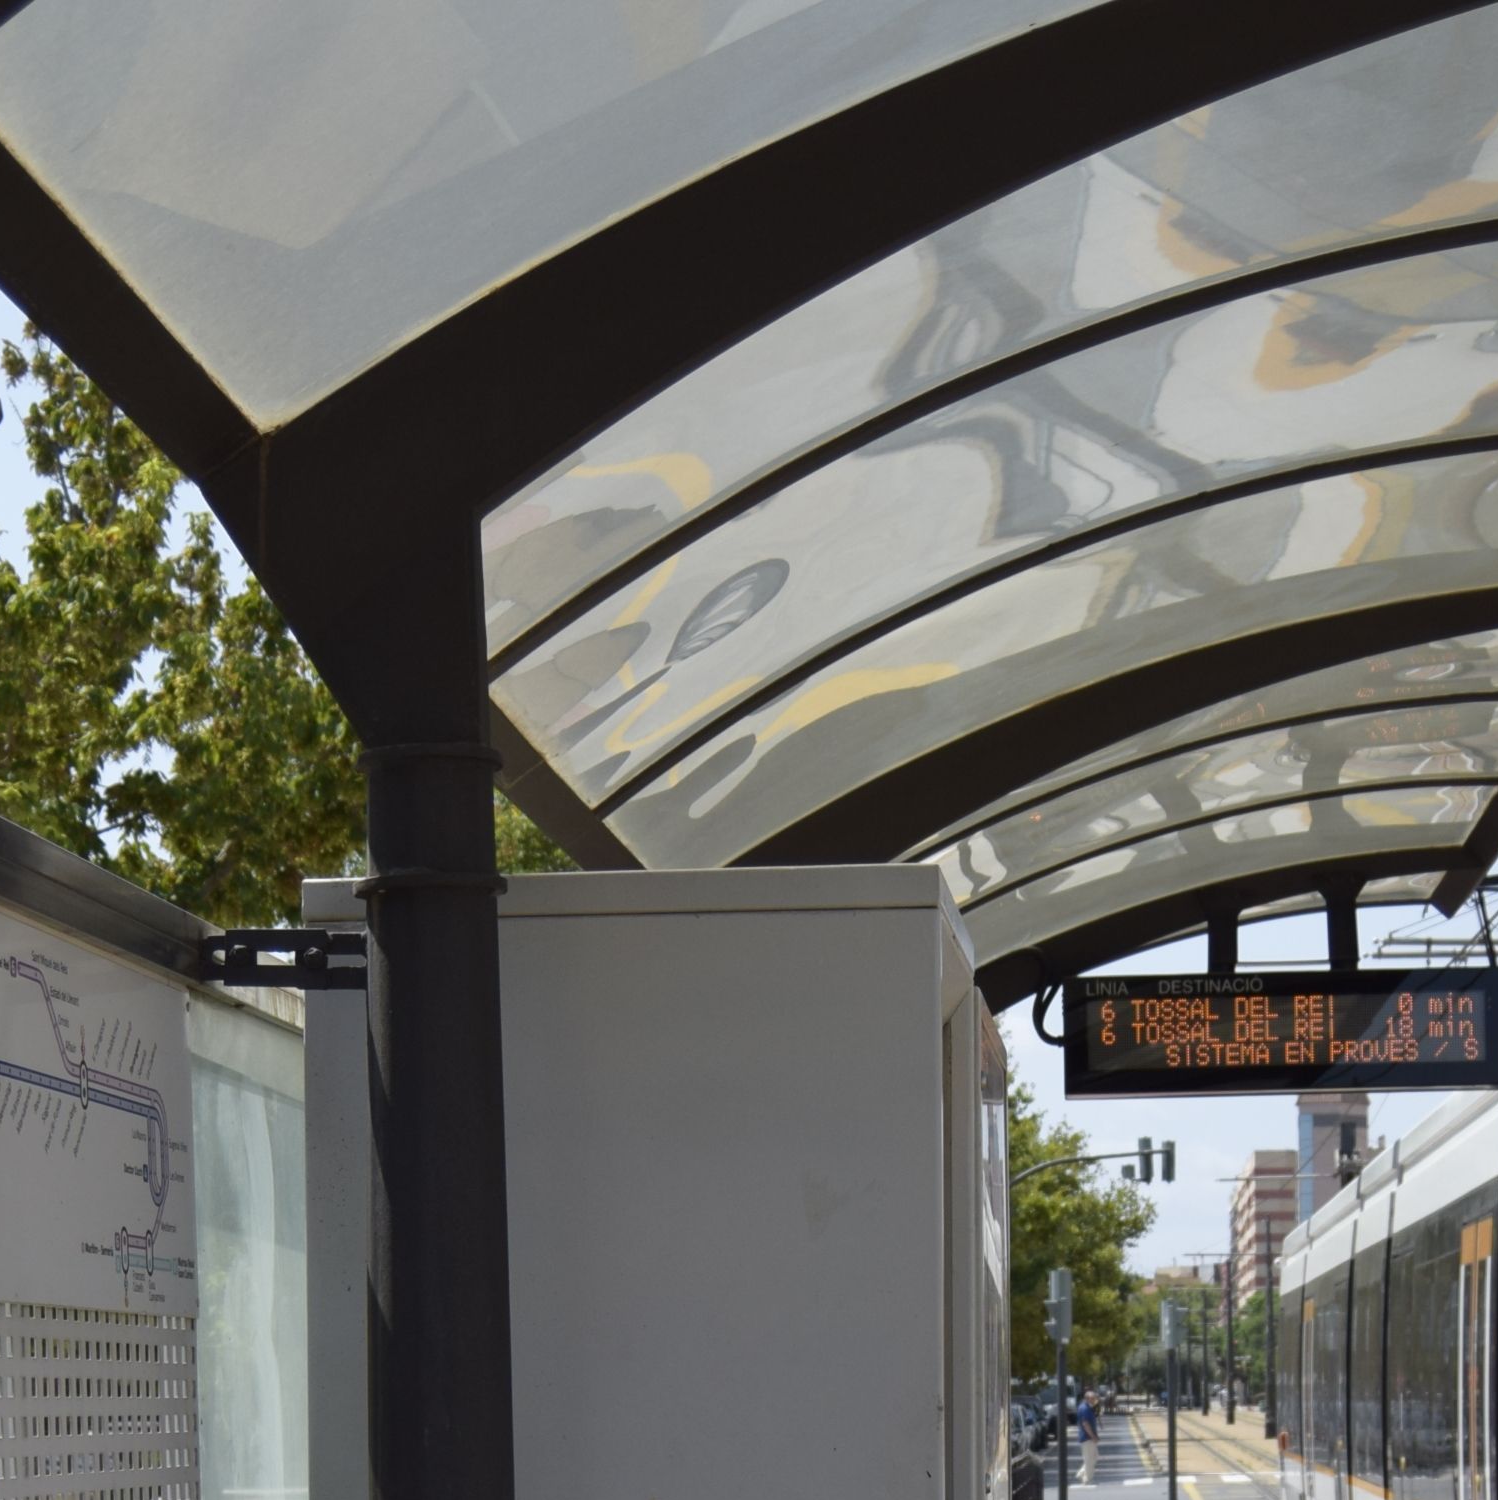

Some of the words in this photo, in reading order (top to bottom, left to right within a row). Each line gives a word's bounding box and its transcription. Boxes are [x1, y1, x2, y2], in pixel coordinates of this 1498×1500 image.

[1086, 980, 1129, 997] LÍNIA
[1158, 975, 1264, 995] DESTINACIÓ
[1101, 1000, 1116, 1022] 6
[1131, 998, 1220, 1021] TOSSAL
[1234, 996, 1279, 1019] DEL
[1293, 994, 1335, 1018] REI
[1398, 992, 1414, 1013] 0
[1428, 992, 1474, 1014] min
[1101, 1022, 1116, 1045] 6
[1131, 1021, 1220, 1044] TOSSAL
[1234, 1019, 1280, 1042] DEL
[1293, 1017, 1335, 1041] REI
[1386, 1016, 1414, 1039] 18
[1428, 1015, 1475, 1038] min
[1166, 1043, 1270, 1067] SISTEMA
[1285, 1040, 1315, 1064] EN
[1329, 1039, 1419, 1063] PROVES
[1464, 1037, 1479, 1061] S
